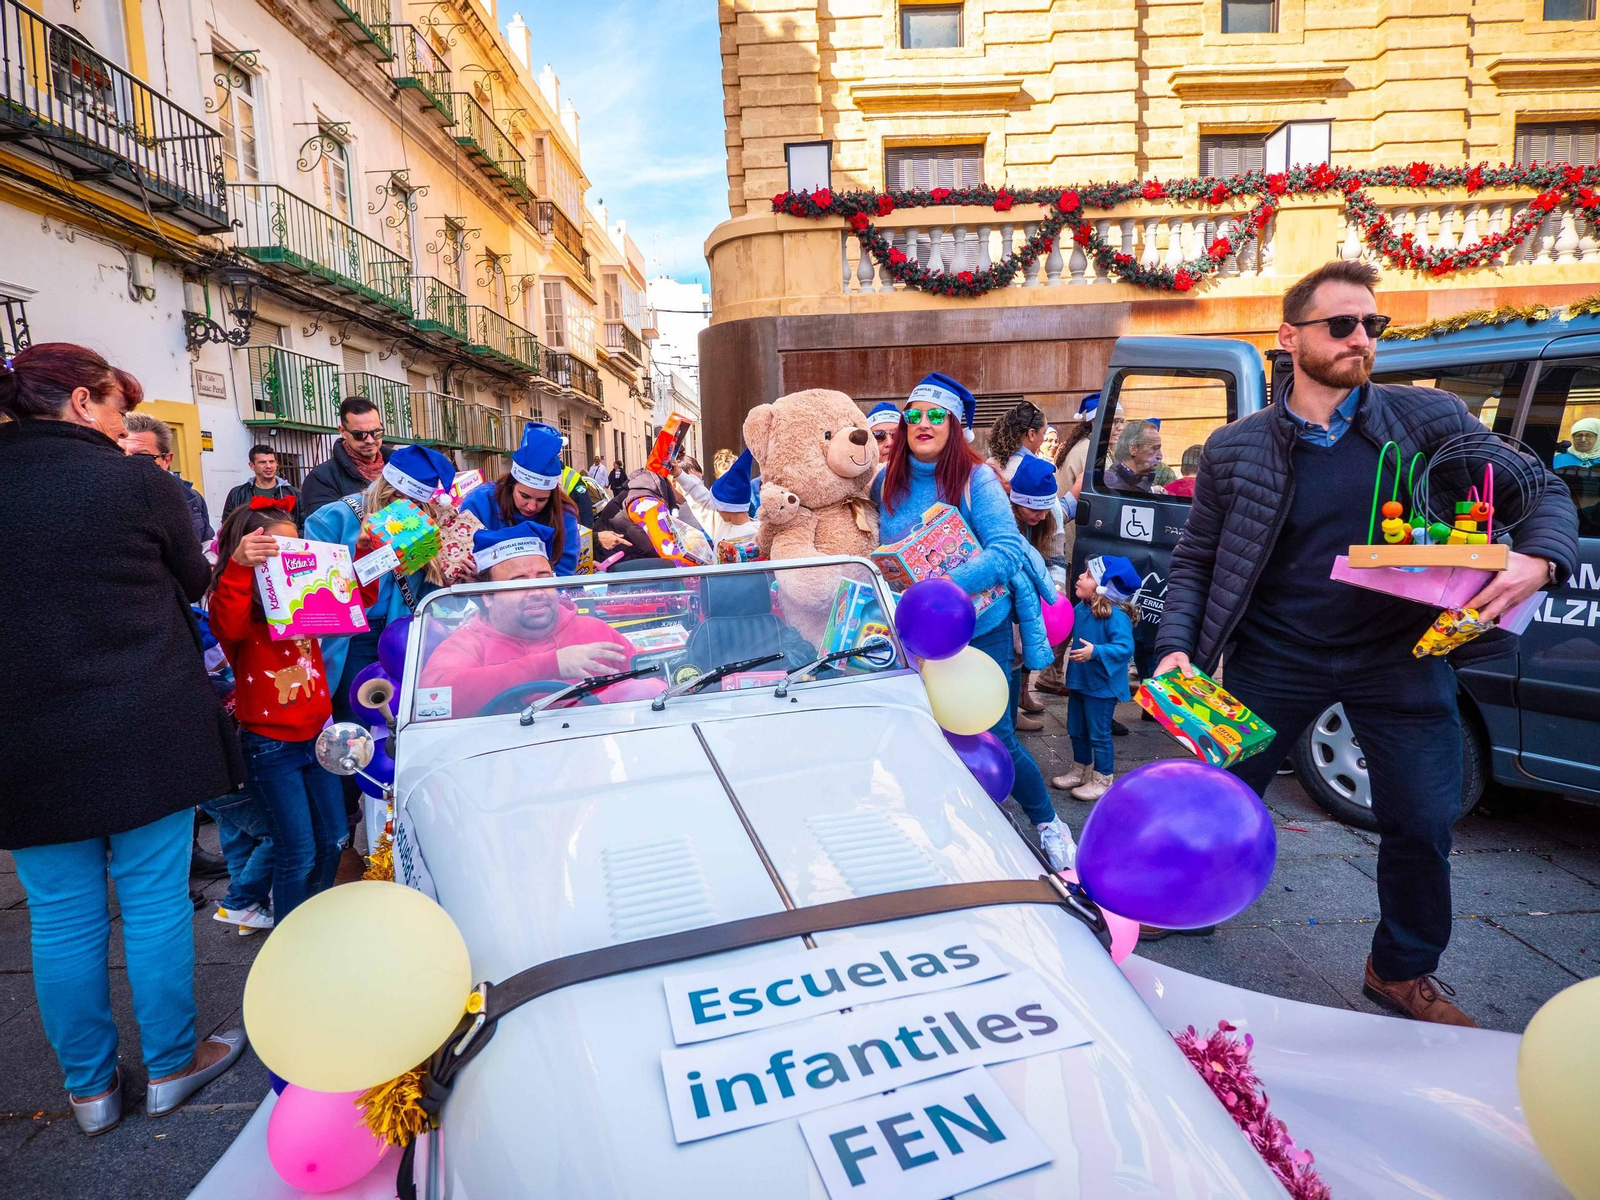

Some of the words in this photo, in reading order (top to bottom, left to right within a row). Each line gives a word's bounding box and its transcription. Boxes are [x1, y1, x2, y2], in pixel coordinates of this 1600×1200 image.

[200, 382, 211, 392] Isaac
[212, 385, 226, 394] Peral
[205, 374, 216, 382] Calle
[688, 944, 980, 1025] Escuelas
[687, 1003, 1059, 1119] infantiles
[828, 1093, 1007, 1187] FEN
